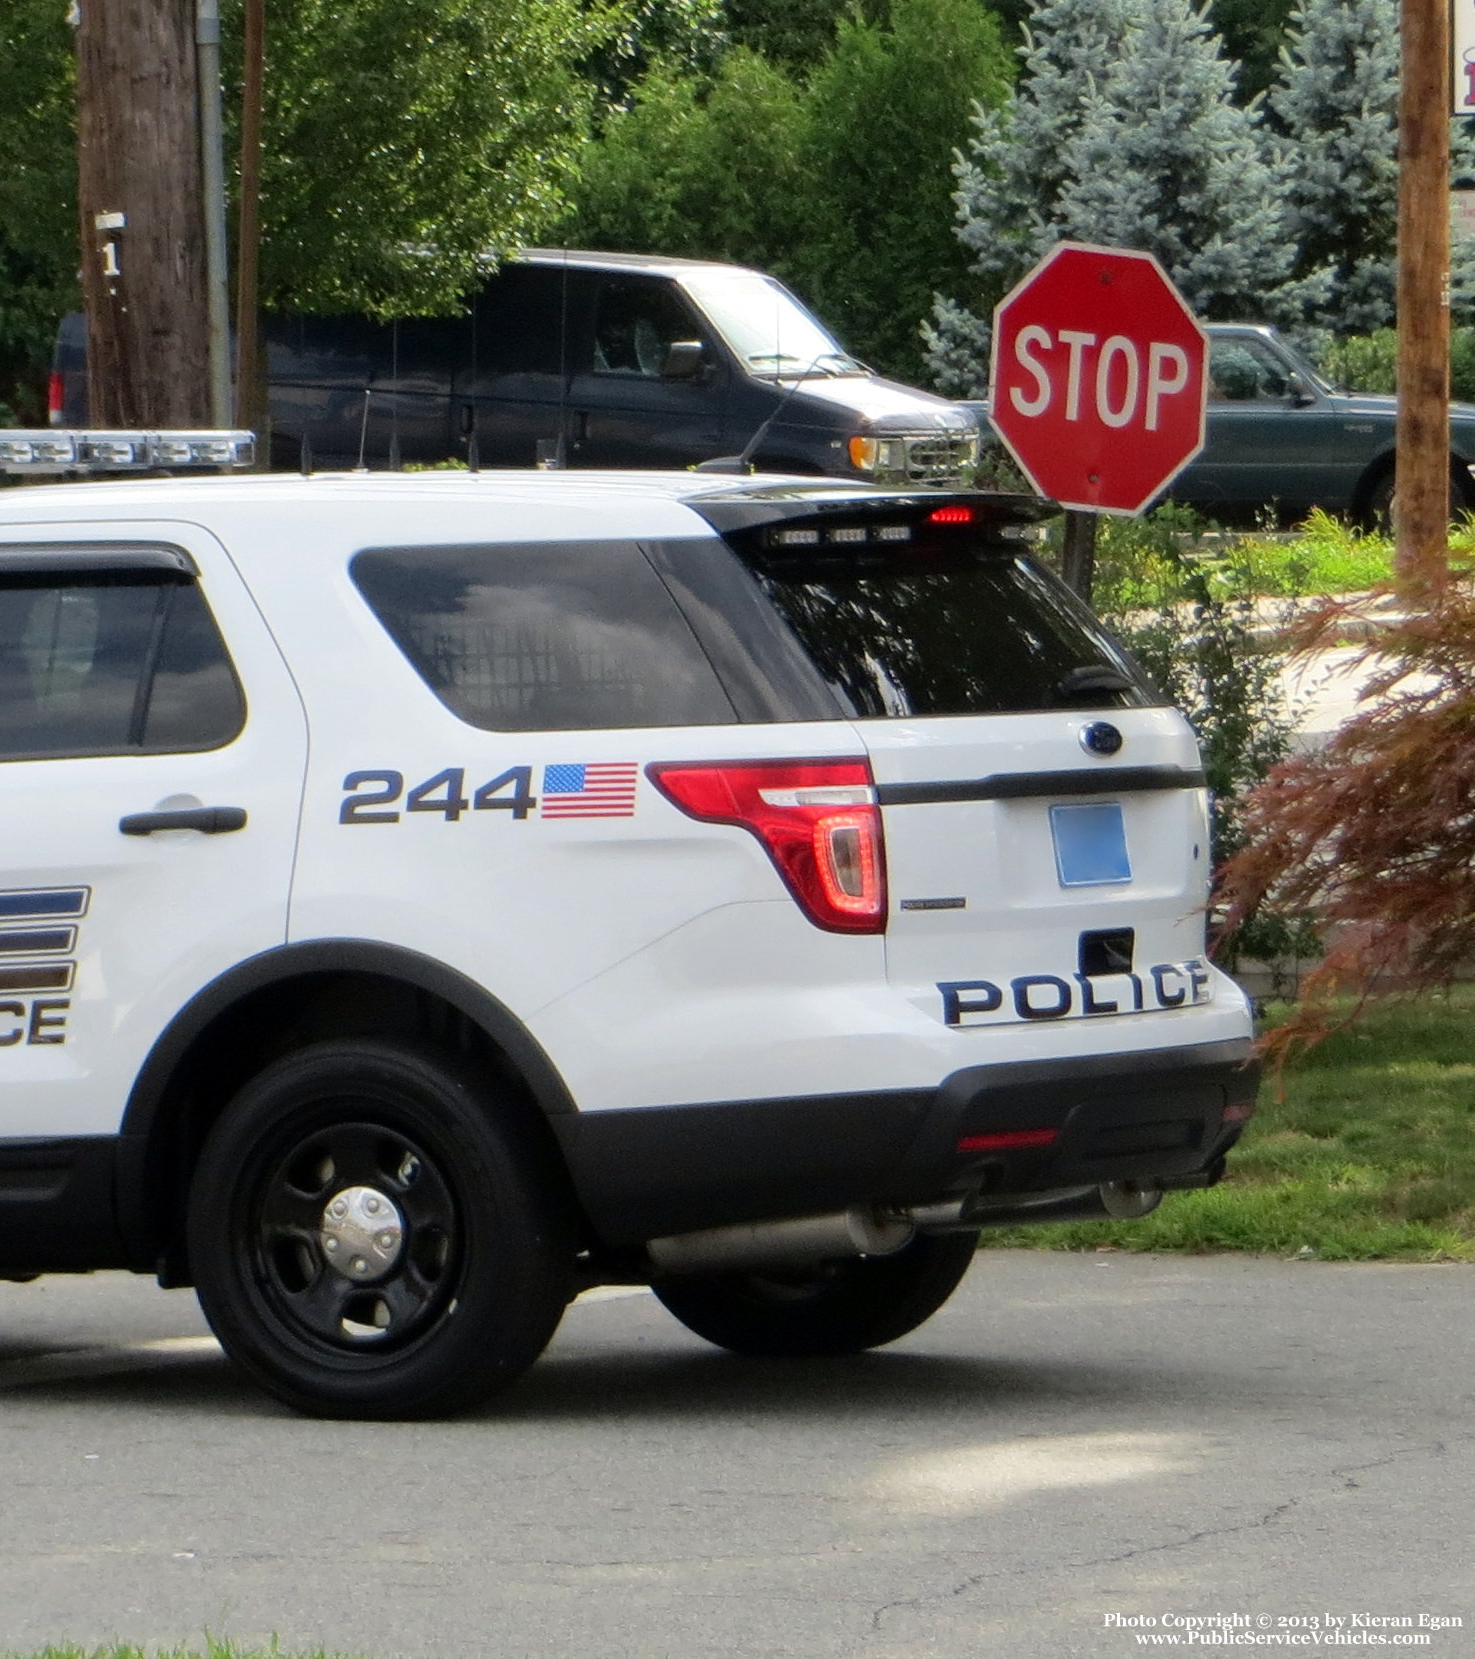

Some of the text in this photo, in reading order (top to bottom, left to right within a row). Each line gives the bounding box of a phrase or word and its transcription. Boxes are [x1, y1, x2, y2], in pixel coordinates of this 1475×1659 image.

[1009, 323, 1191, 433] STOP
[339, 766, 537, 825] 244
[935, 960, 1210, 1026] POLICE
